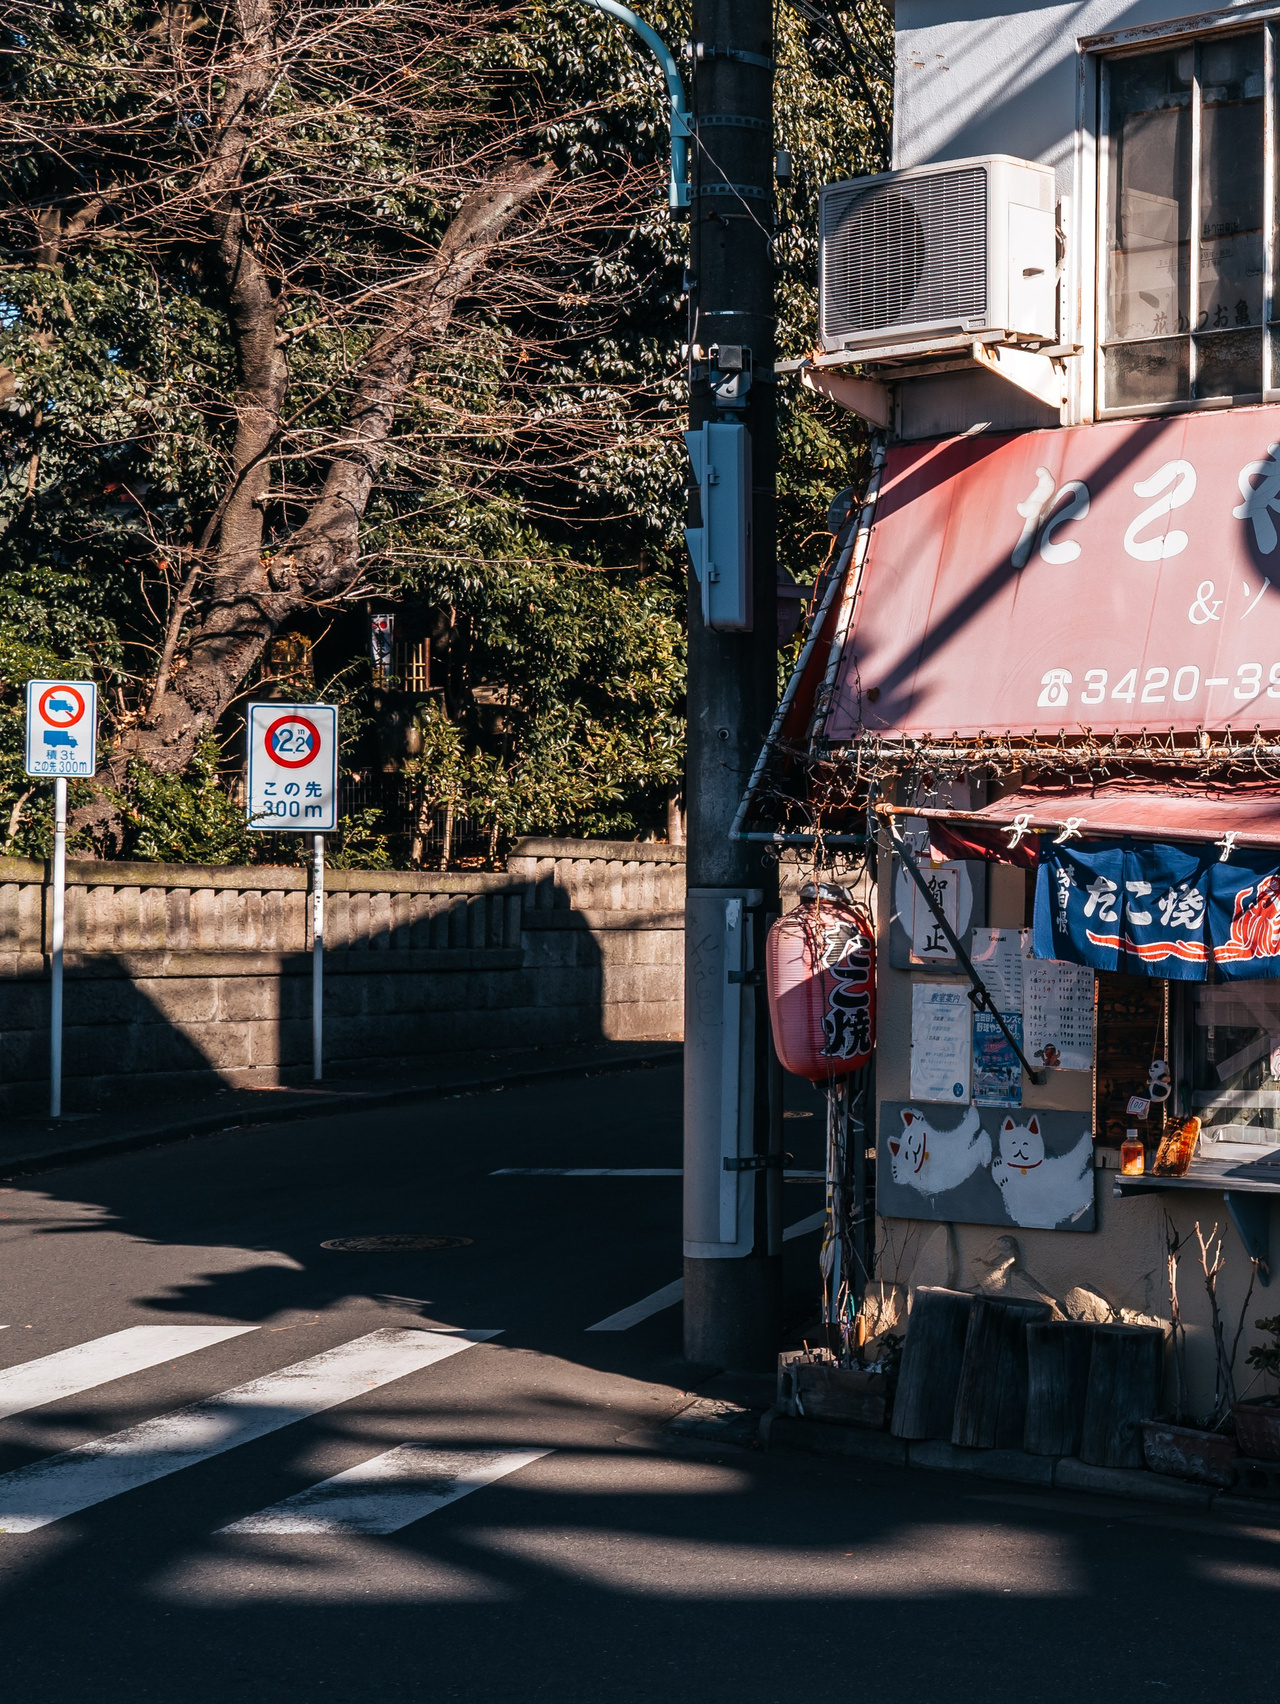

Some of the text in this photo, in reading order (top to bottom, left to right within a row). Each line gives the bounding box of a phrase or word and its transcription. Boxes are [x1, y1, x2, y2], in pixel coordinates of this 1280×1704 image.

[1188, 580, 1223, 625] &
[263, 781, 322, 797] この先
[922, 874, 949, 954] 賀正
[1056, 863, 1078, 935] 味自慢
[1083, 875, 1205, 930] たこ焼
[819, 921, 873, 1061] たこ焼
